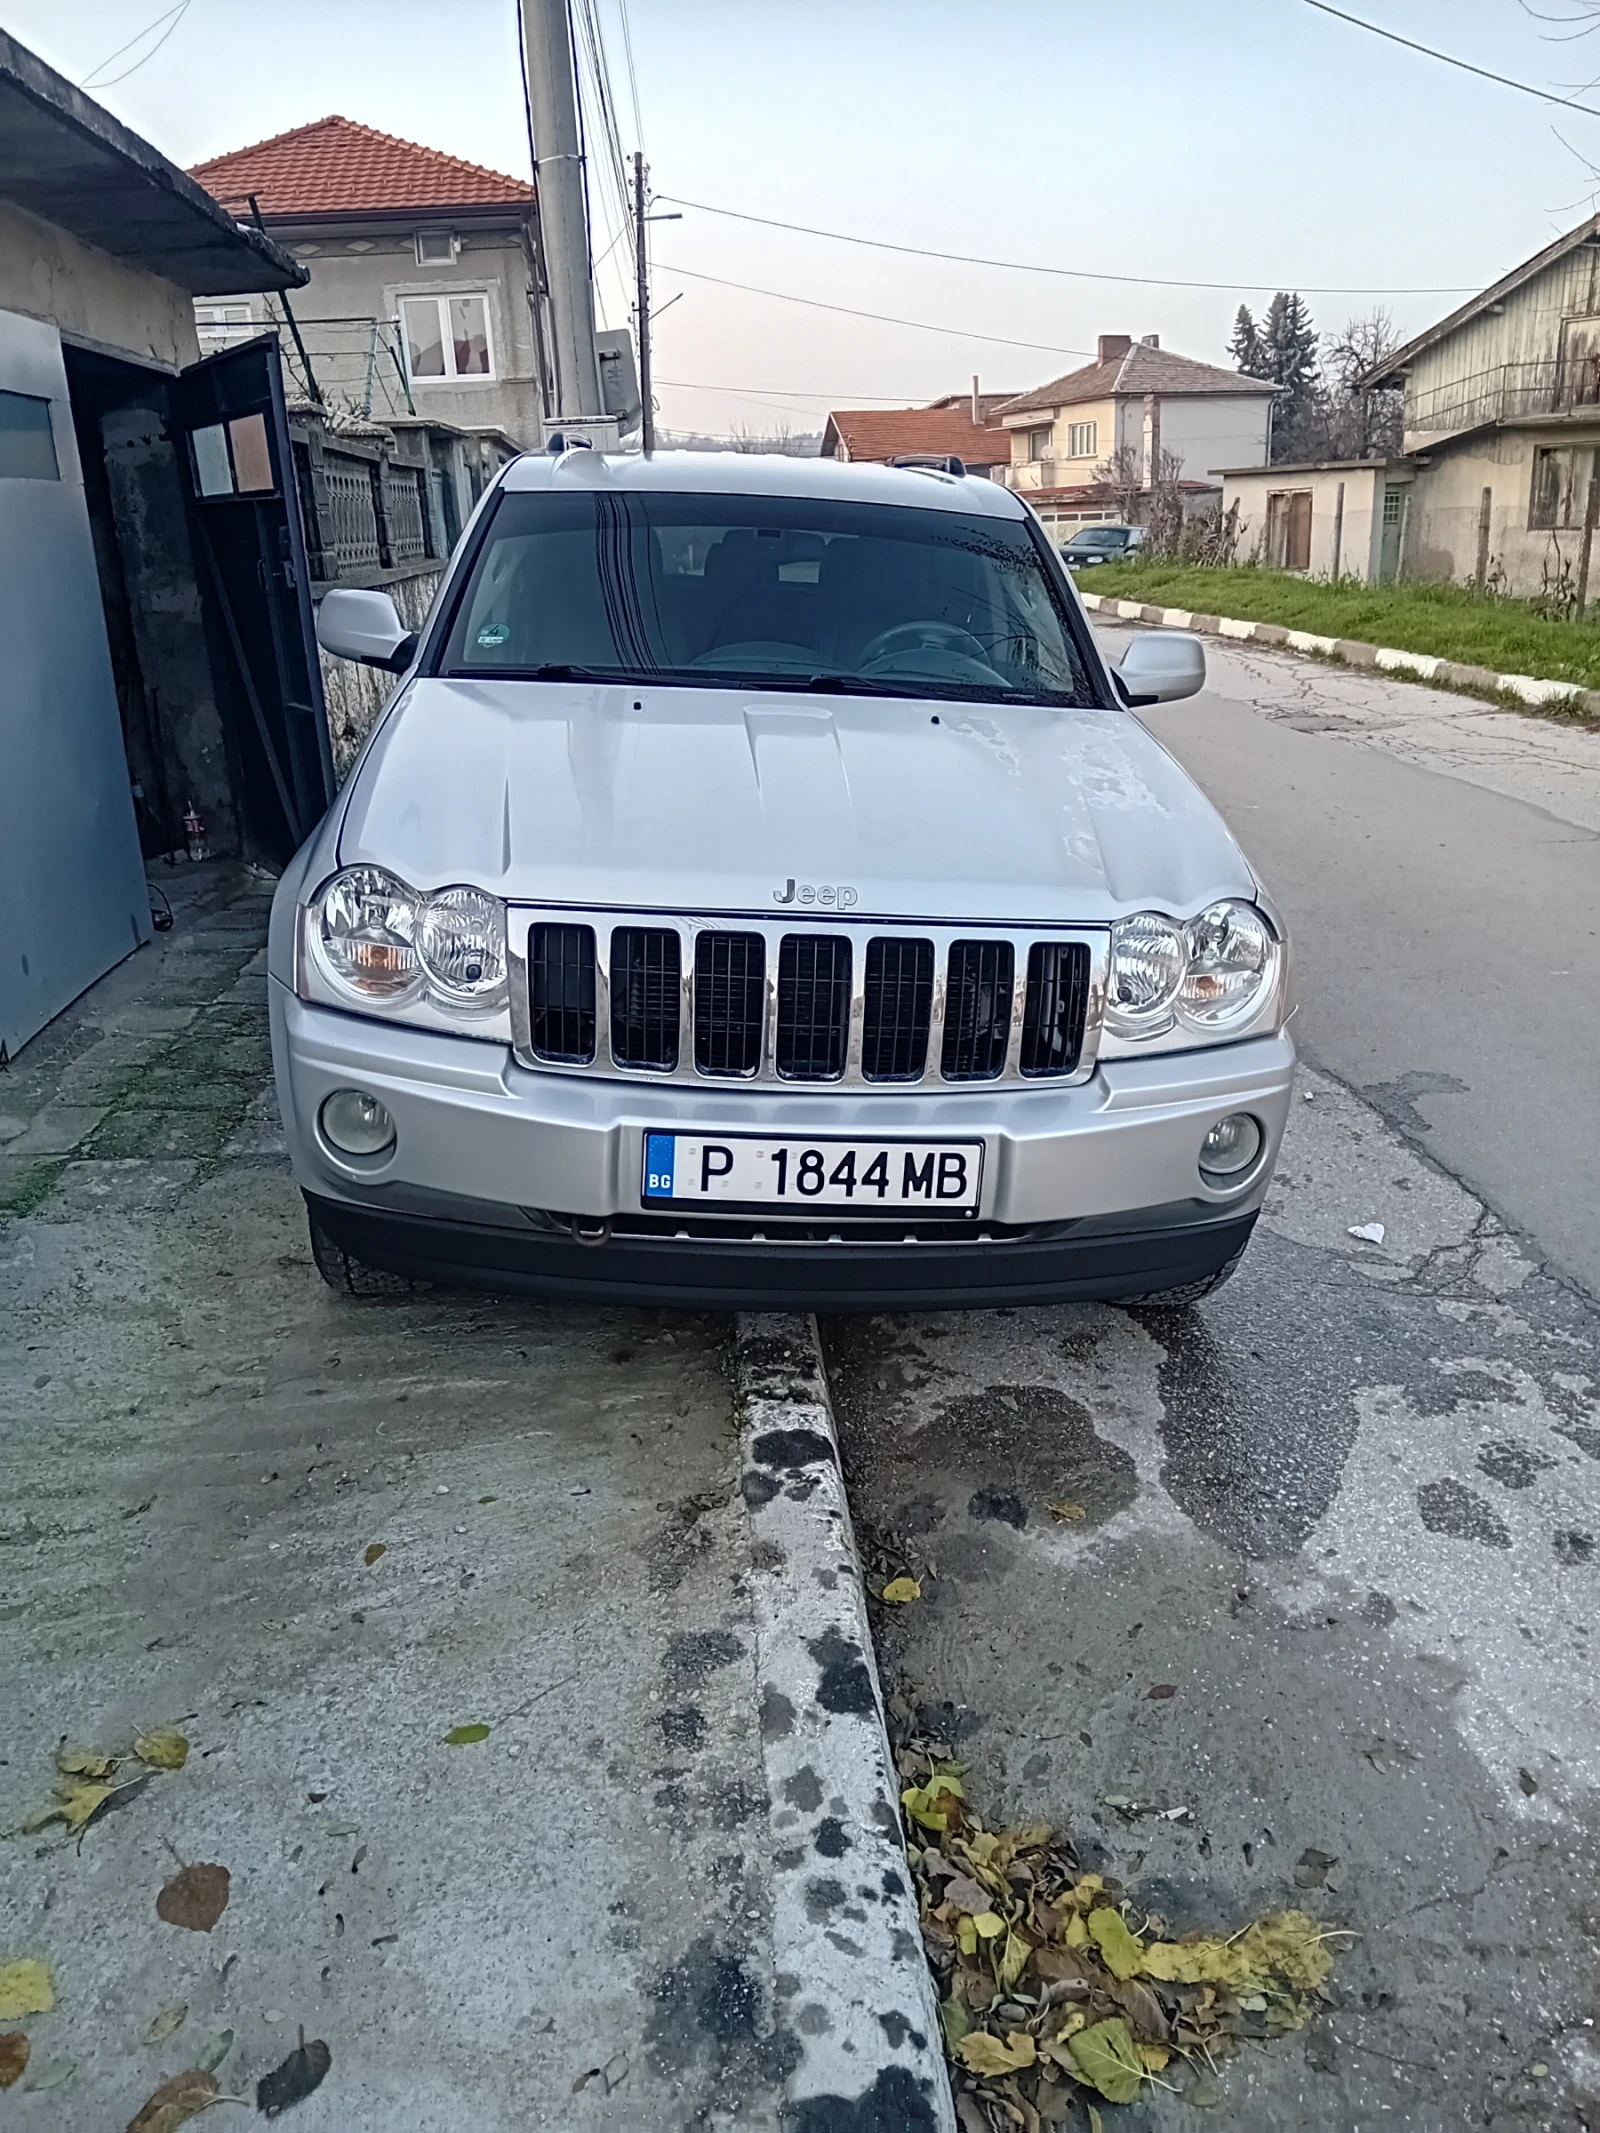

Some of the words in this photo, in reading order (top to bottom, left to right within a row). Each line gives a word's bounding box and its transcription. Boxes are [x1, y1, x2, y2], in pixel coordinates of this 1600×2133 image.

[772, 878, 858, 910] Jeep
[649, 1173, 671, 1189] BG
[701, 1145, 734, 1192] P
[771, 1148, 889, 1197] 1844
[901, 1152, 968, 1199] MB
